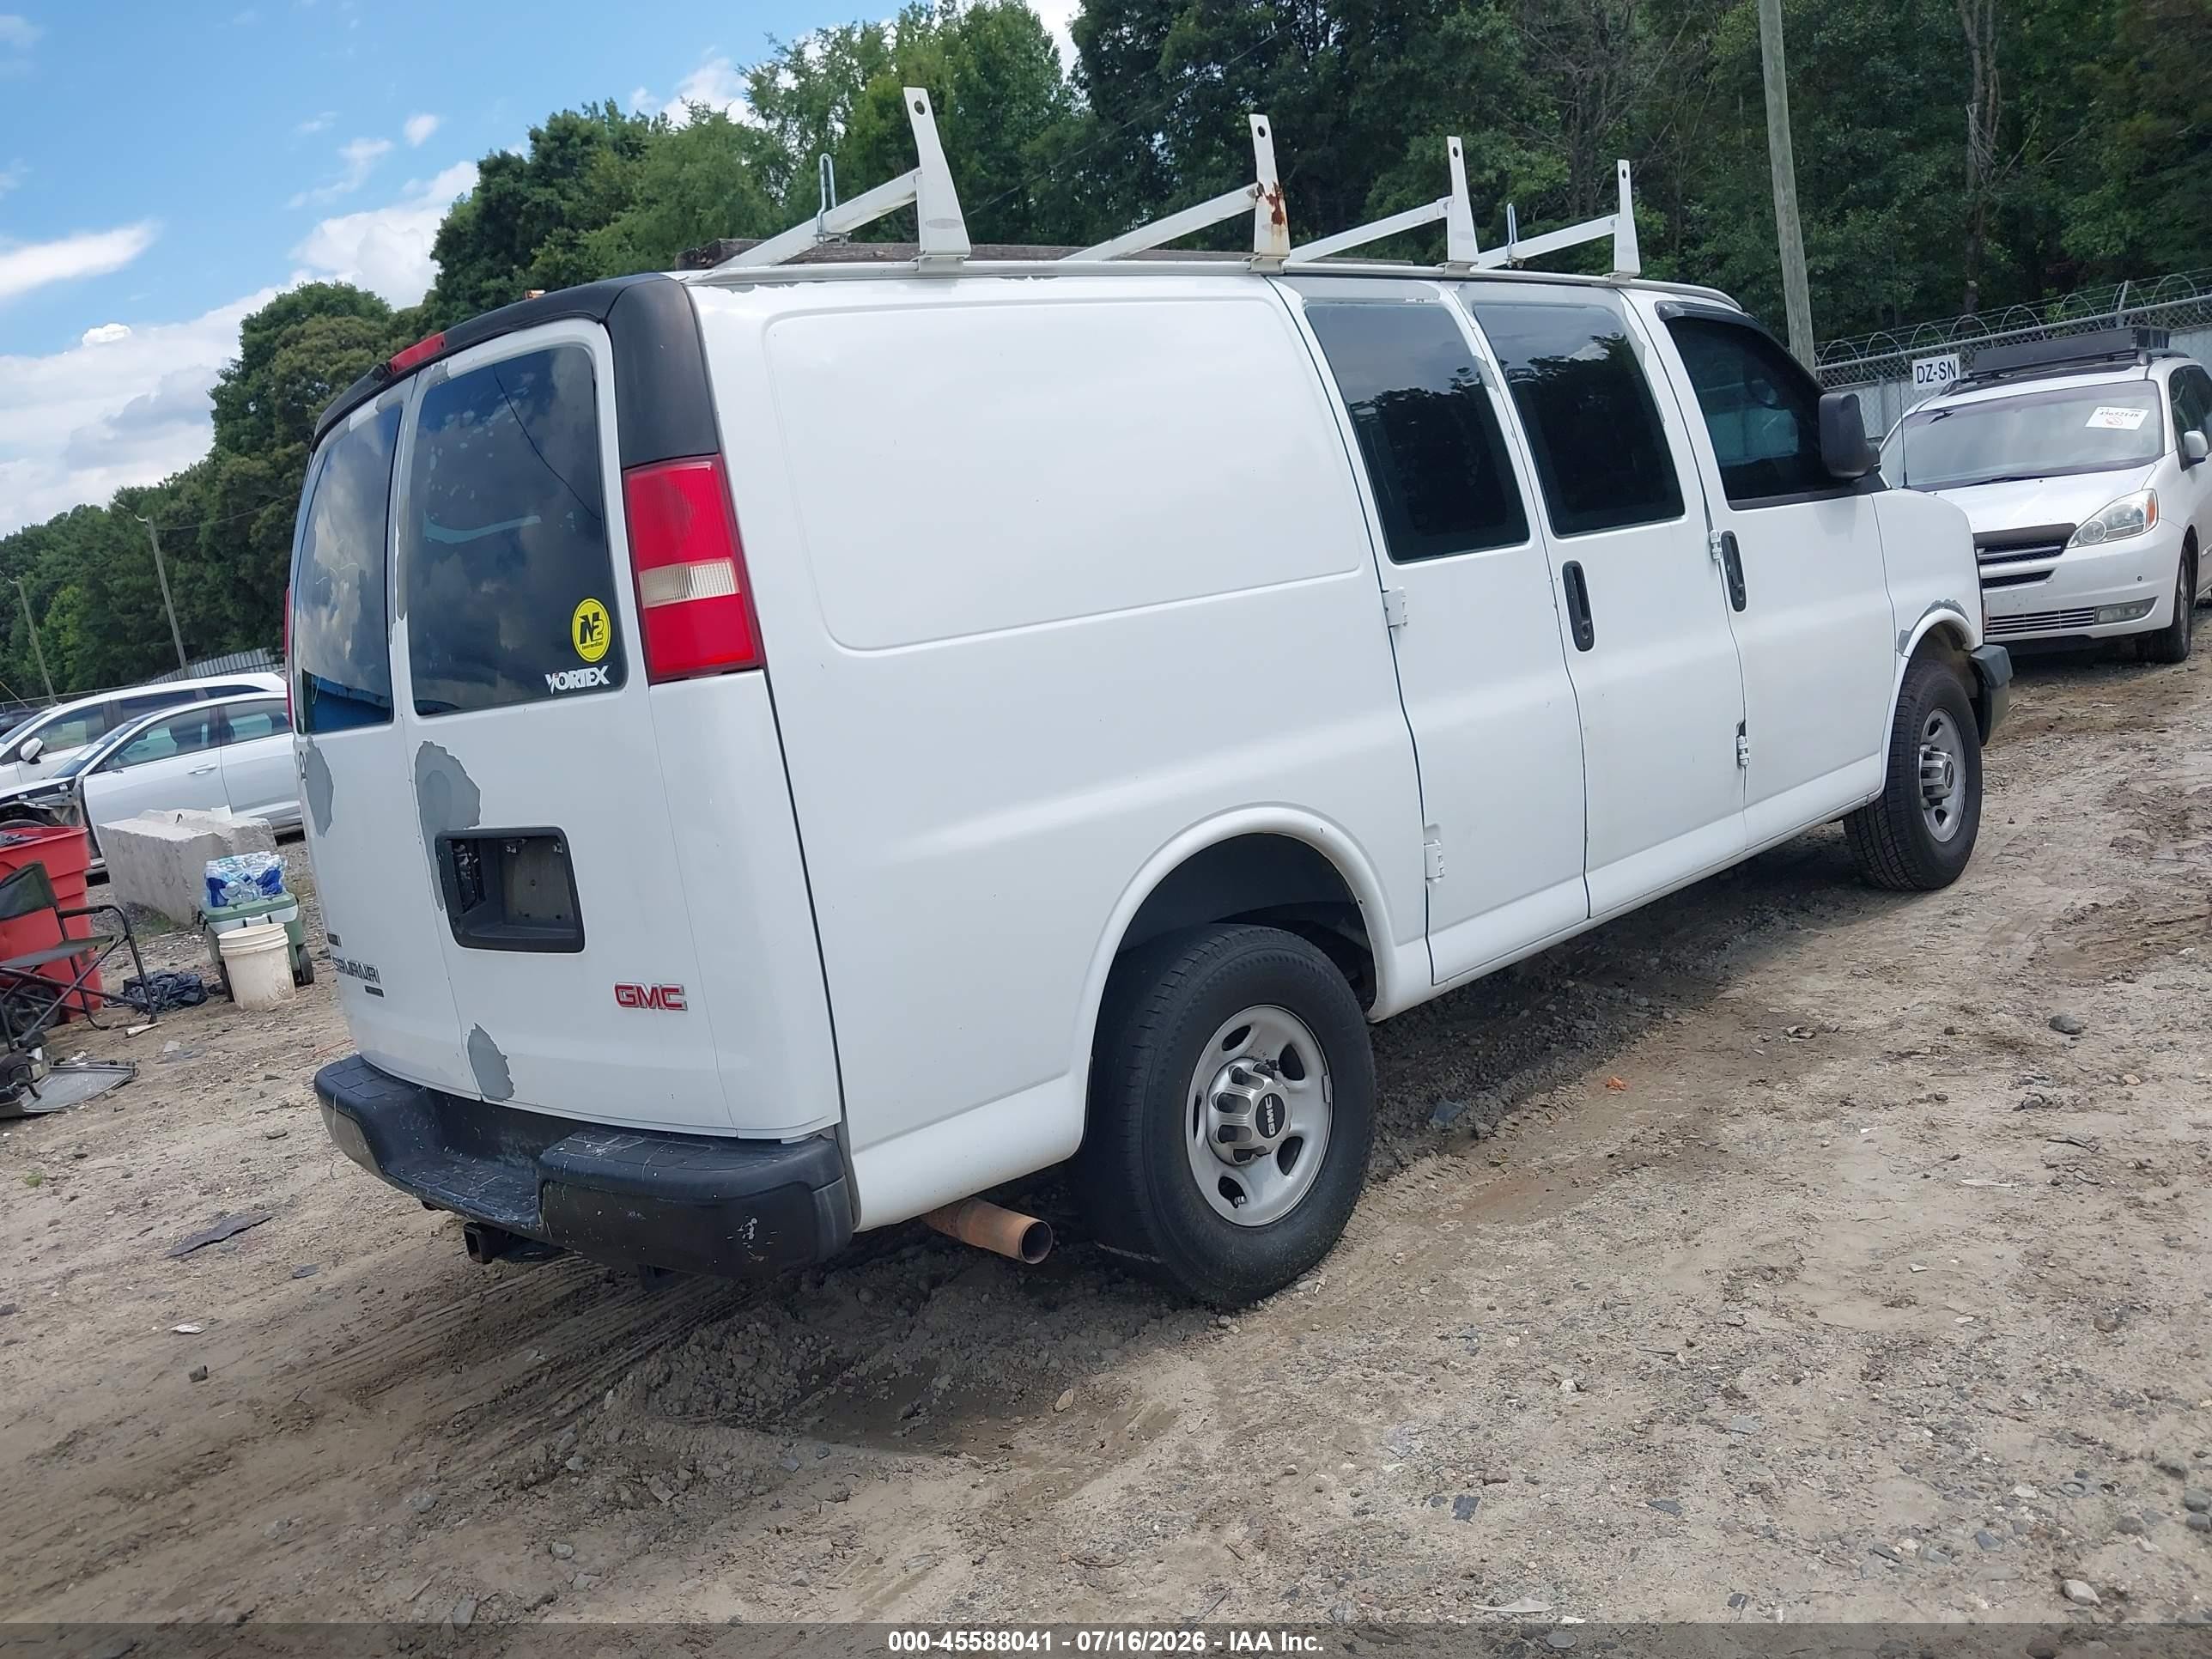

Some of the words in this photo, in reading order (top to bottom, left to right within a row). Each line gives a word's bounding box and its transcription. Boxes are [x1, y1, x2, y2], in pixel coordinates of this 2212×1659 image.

[1917, 360, 1956, 384] DZ-SN
[544, 665, 611, 694] VORTEX
[613, 981, 688, 1011] GMC
[1264, 1096, 1275, 1135] GMC
